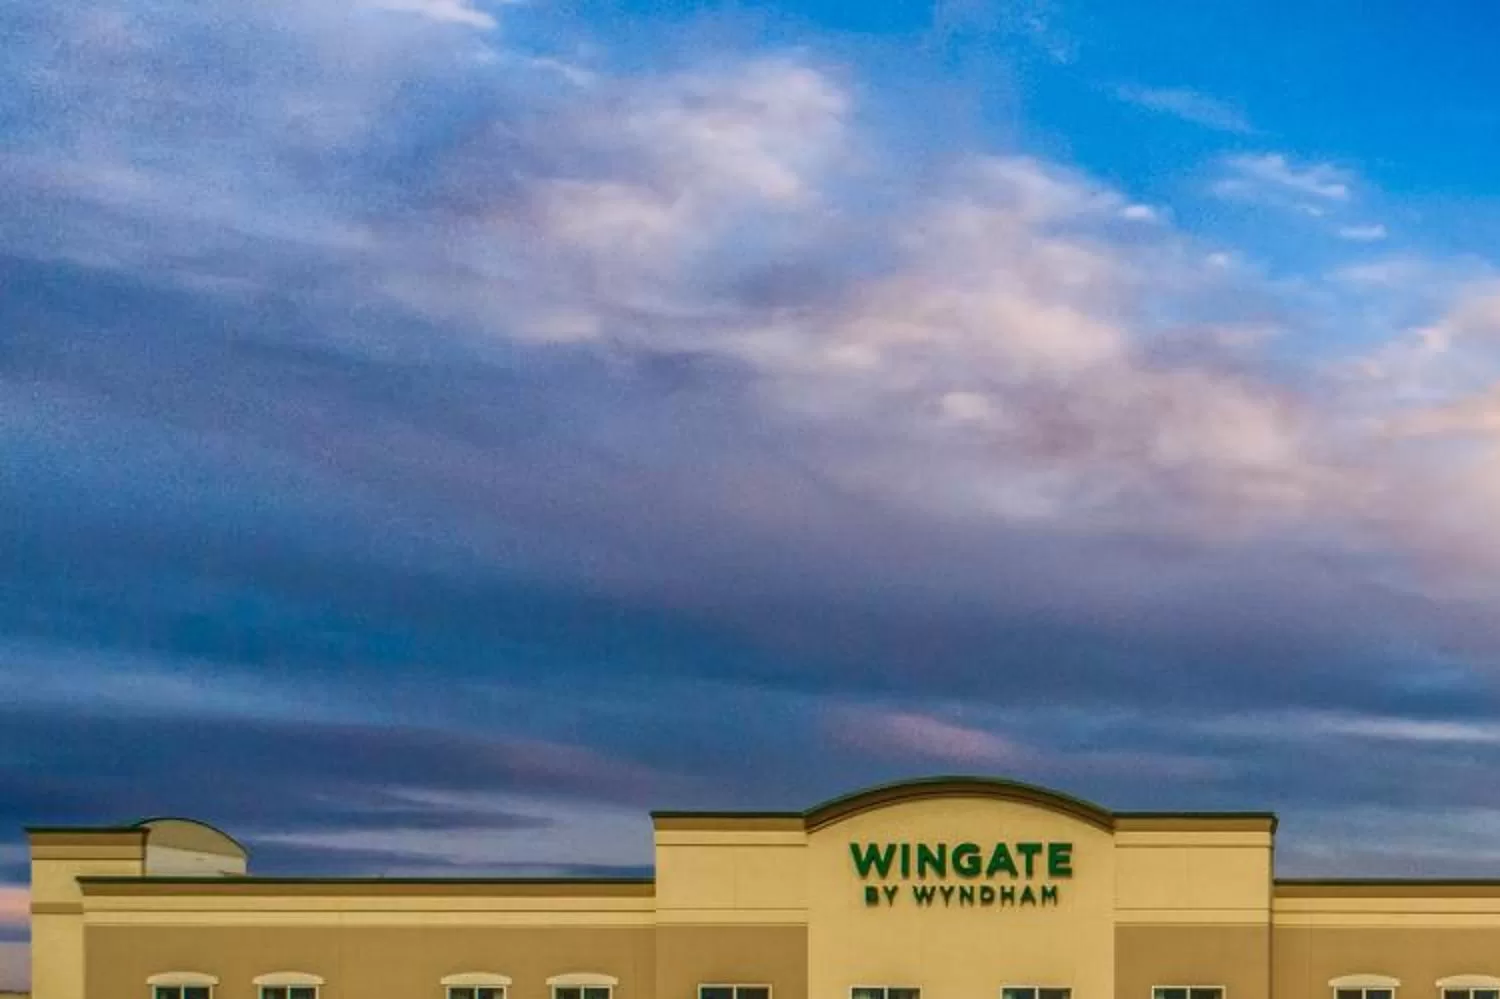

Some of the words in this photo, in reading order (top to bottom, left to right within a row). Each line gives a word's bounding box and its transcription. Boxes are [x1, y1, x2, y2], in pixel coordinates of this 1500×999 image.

[849, 842, 1073, 879] WINGATE
[864, 886, 898, 908] BY
[913, 886, 1059, 908] WYNDHAM
